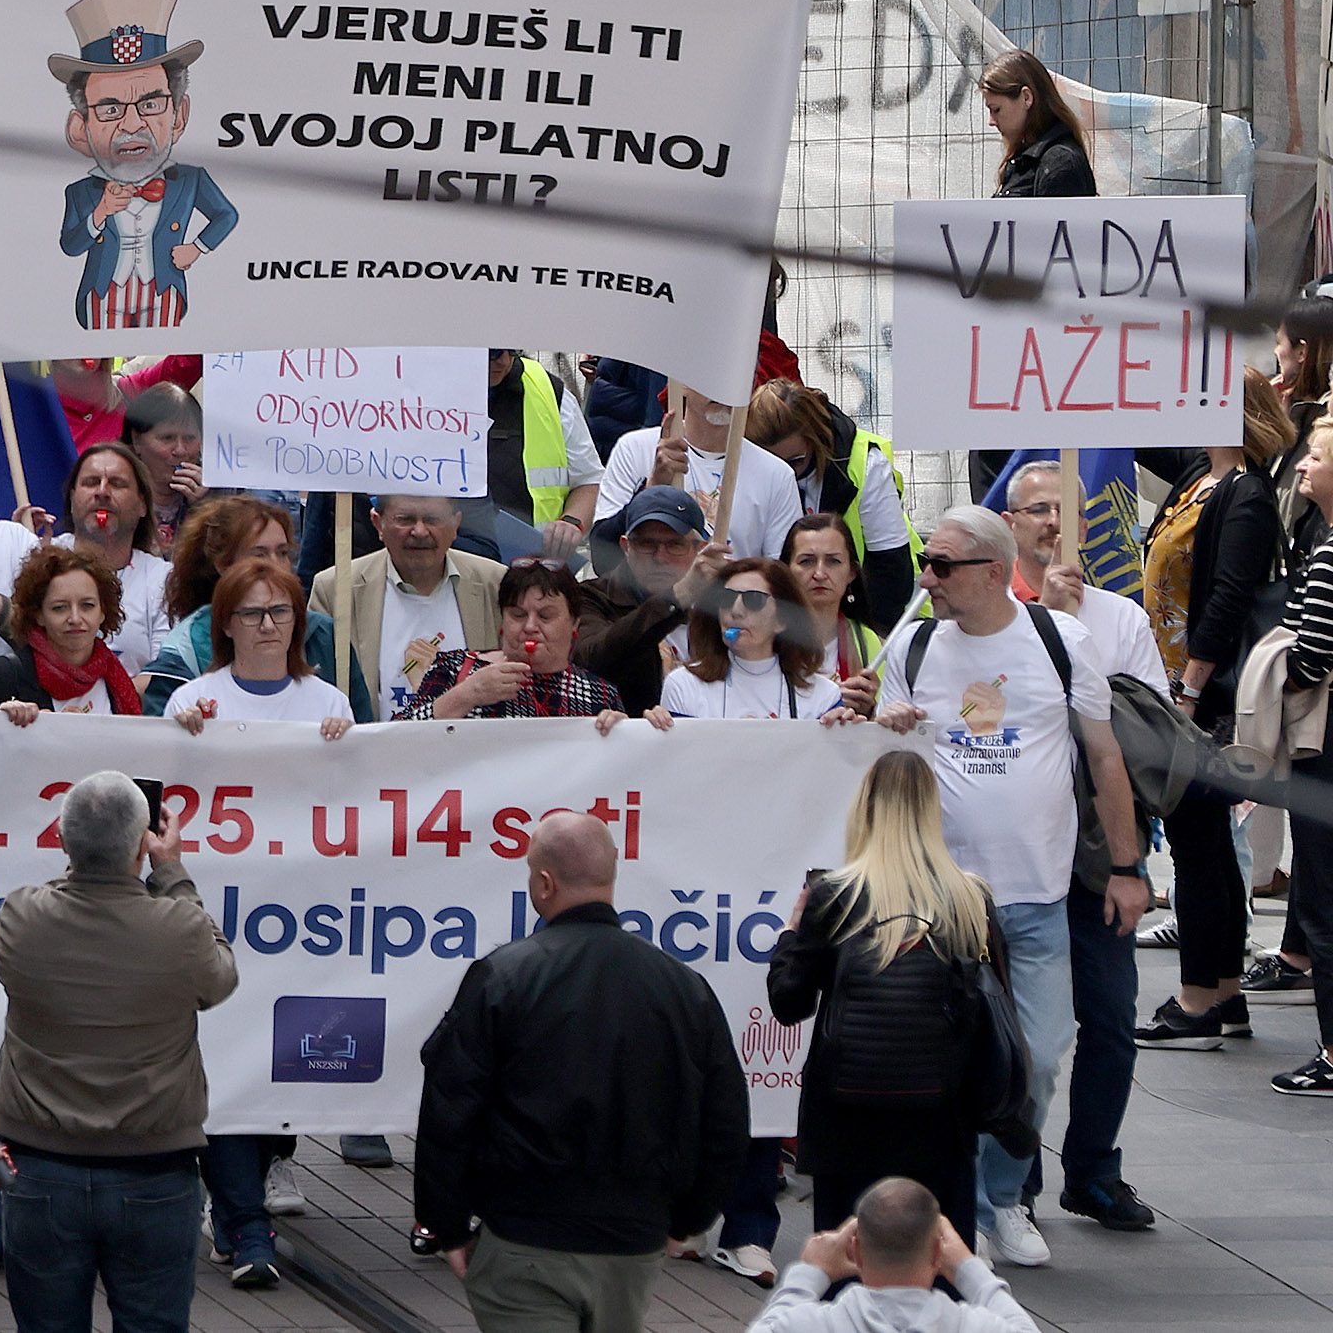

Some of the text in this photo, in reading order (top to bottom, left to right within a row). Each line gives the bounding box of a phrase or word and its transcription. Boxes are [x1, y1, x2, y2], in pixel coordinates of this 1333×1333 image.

[262, 4, 683, 62] VJERUJEŠ LI TI
[352, 61, 594, 107] MENI ILI
[216, 112, 732, 178] SVOJOJ PLATNOJ
[246, 258, 676, 304] UNCLE RADOVAN TE TREBA
[940, 219, 1188, 300] VLADA
[968, 310, 1232, 412] LAŽE!!!
[256, 393, 483, 445] ODGOVORNOST,
[217, 434, 471, 495] NE PODOBNOST!
[963, 746, 1021, 760] obrazovanje
[967, 762, 1007, 775] znanost
[312, 806, 360, 857] u
[379, 789, 472, 858] 14
